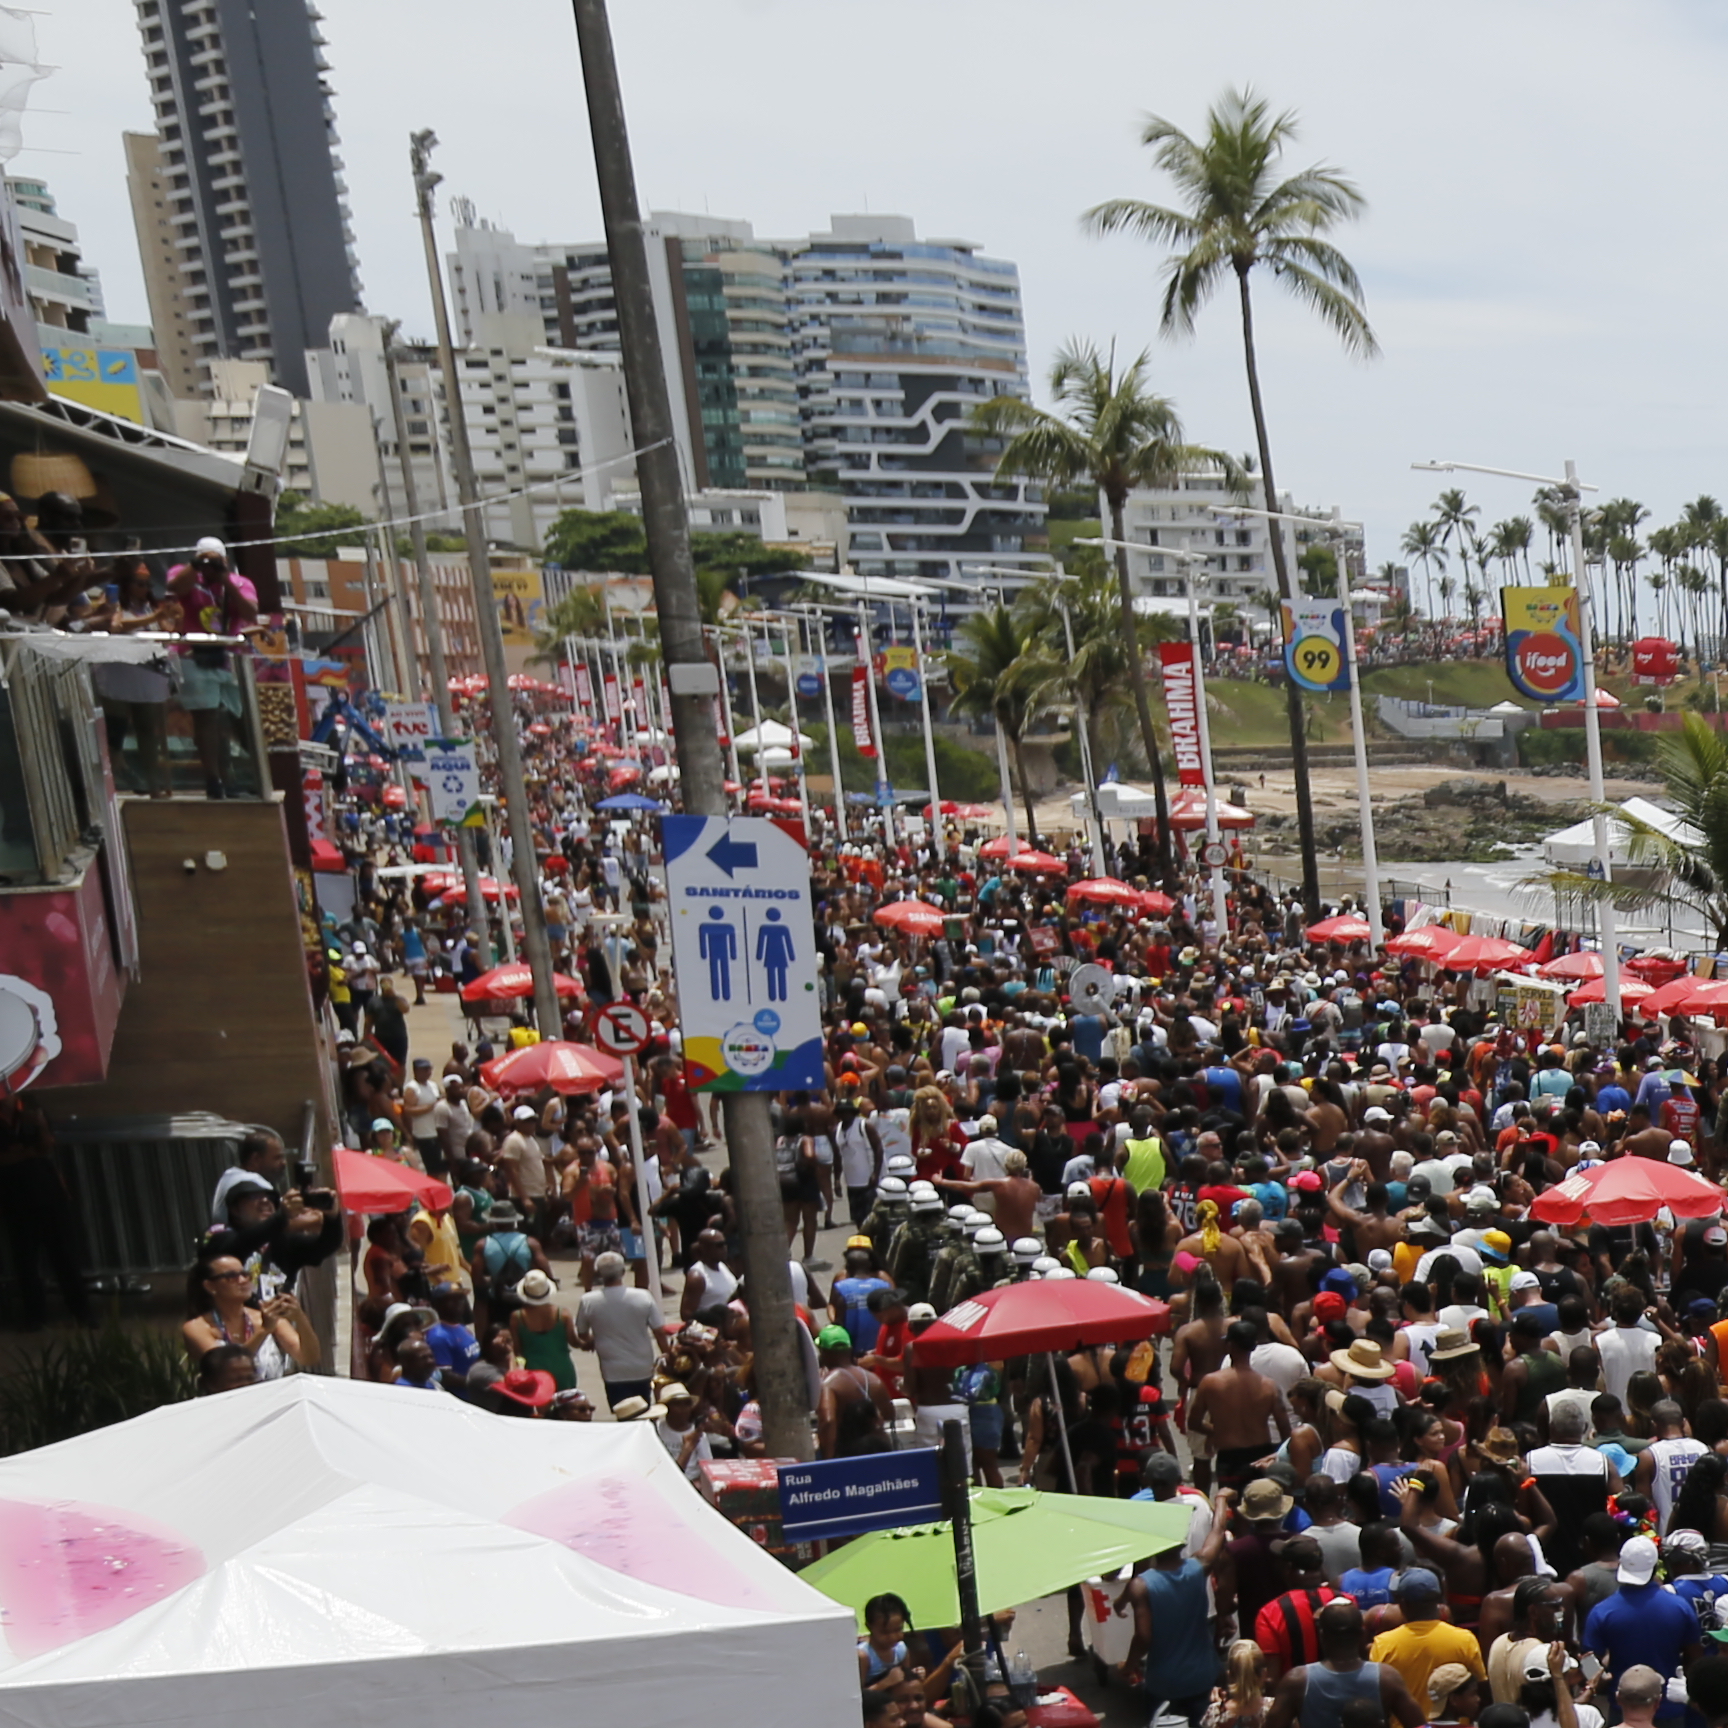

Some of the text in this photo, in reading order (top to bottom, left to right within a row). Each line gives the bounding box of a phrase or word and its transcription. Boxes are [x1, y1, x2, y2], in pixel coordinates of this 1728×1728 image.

[1302, 650, 1331, 669] 99
[1162, 659, 1201, 770] BRAHMA
[685, 884, 801, 901] SANITÁRIOS
[785, 1474, 812, 1487] Rua
[789, 1477, 919, 1505] Alfredo Magalhães
